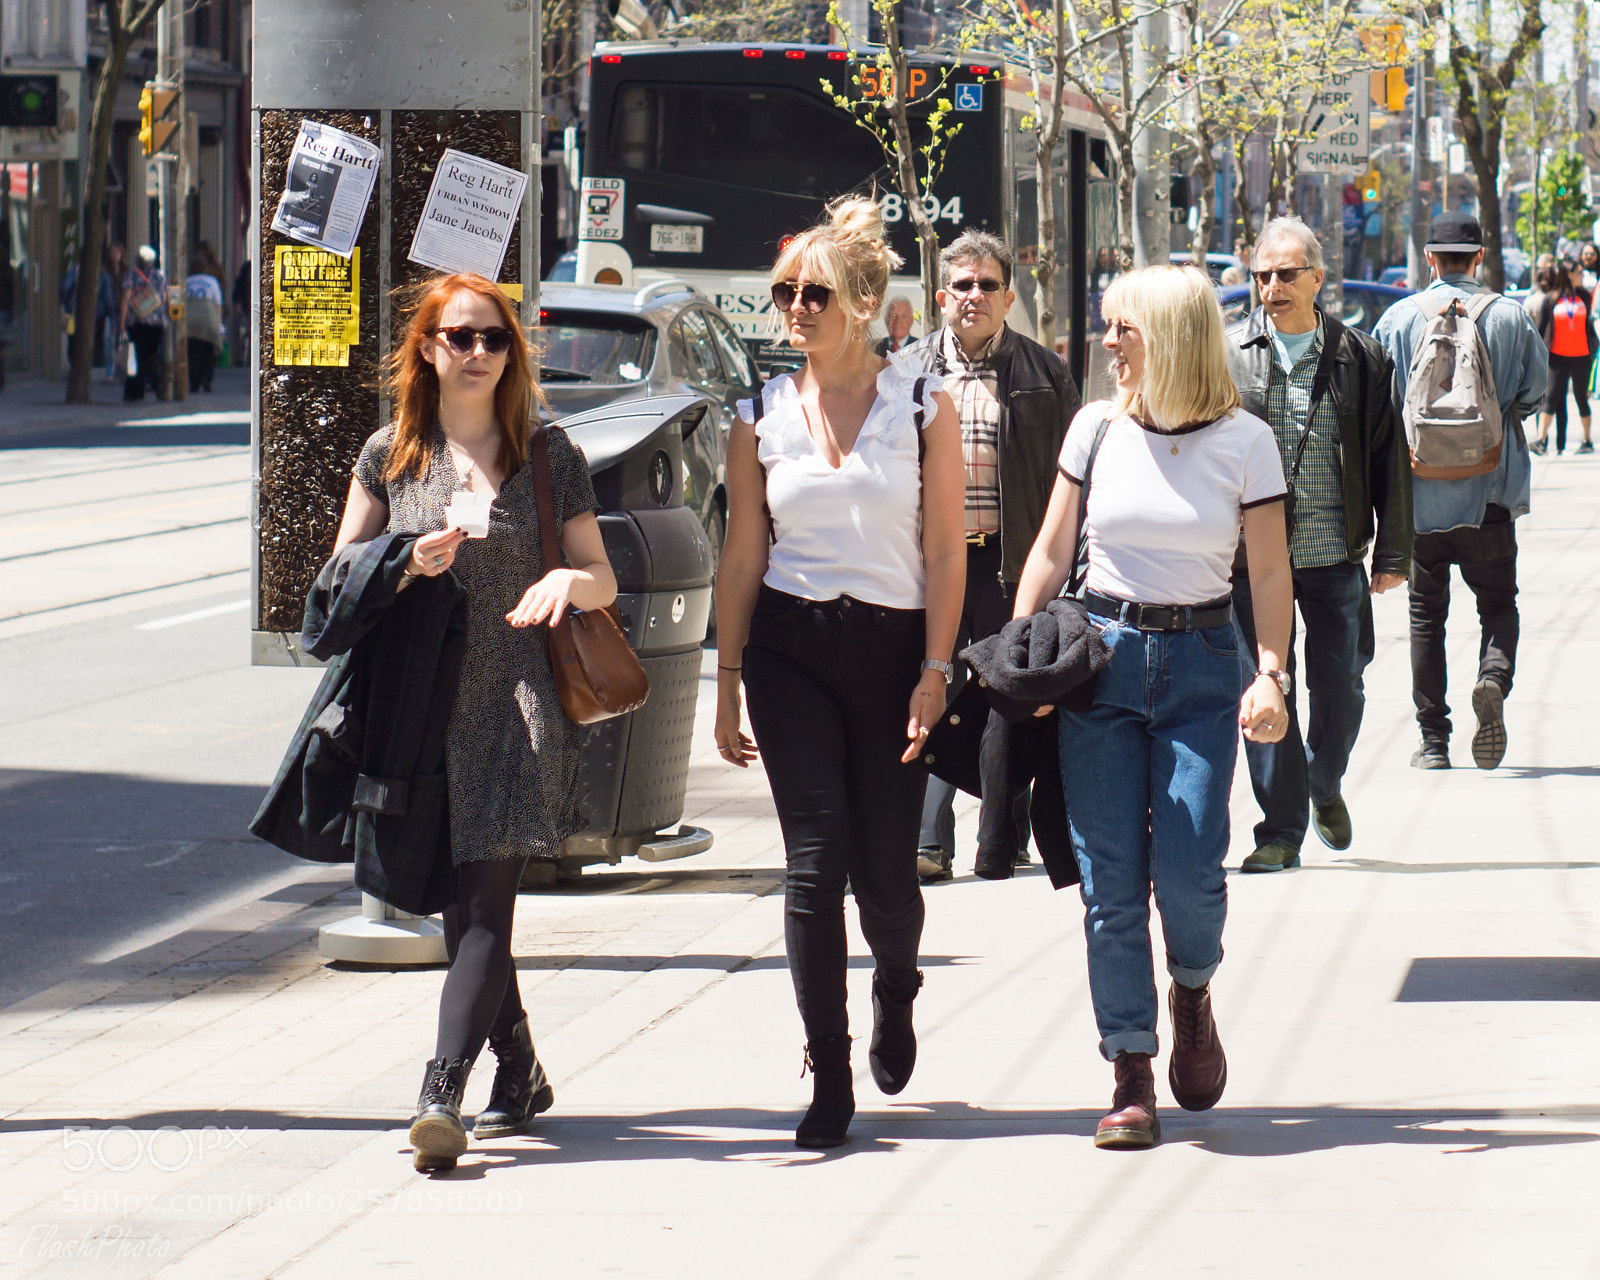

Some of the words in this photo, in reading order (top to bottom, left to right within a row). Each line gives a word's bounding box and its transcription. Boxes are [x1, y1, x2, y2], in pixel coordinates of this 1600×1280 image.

[1314, 92, 1353, 106] HERE
[1340, 112, 1359, 126] ON
[1329, 132, 1359, 146] RED
[302, 135, 328, 158] Reg
[332, 146, 373, 169] Hartt
[1306, 152, 1360, 166] SIGNAL
[447, 165, 476, 189] Reg
[479, 176, 513, 199] Hartt
[584, 179, 620, 190] YIELD
[437, 189, 470, 206] URBAN
[471, 199, 512, 220] WISDOM
[880, 193, 964, 225] 894
[428, 208, 459, 227] Jane
[460, 219, 504, 243] Jacobs
[282, 252, 351, 267] GRADUATE
[285, 266, 317, 280] DEBT
[318, 267, 348, 280] FREE
